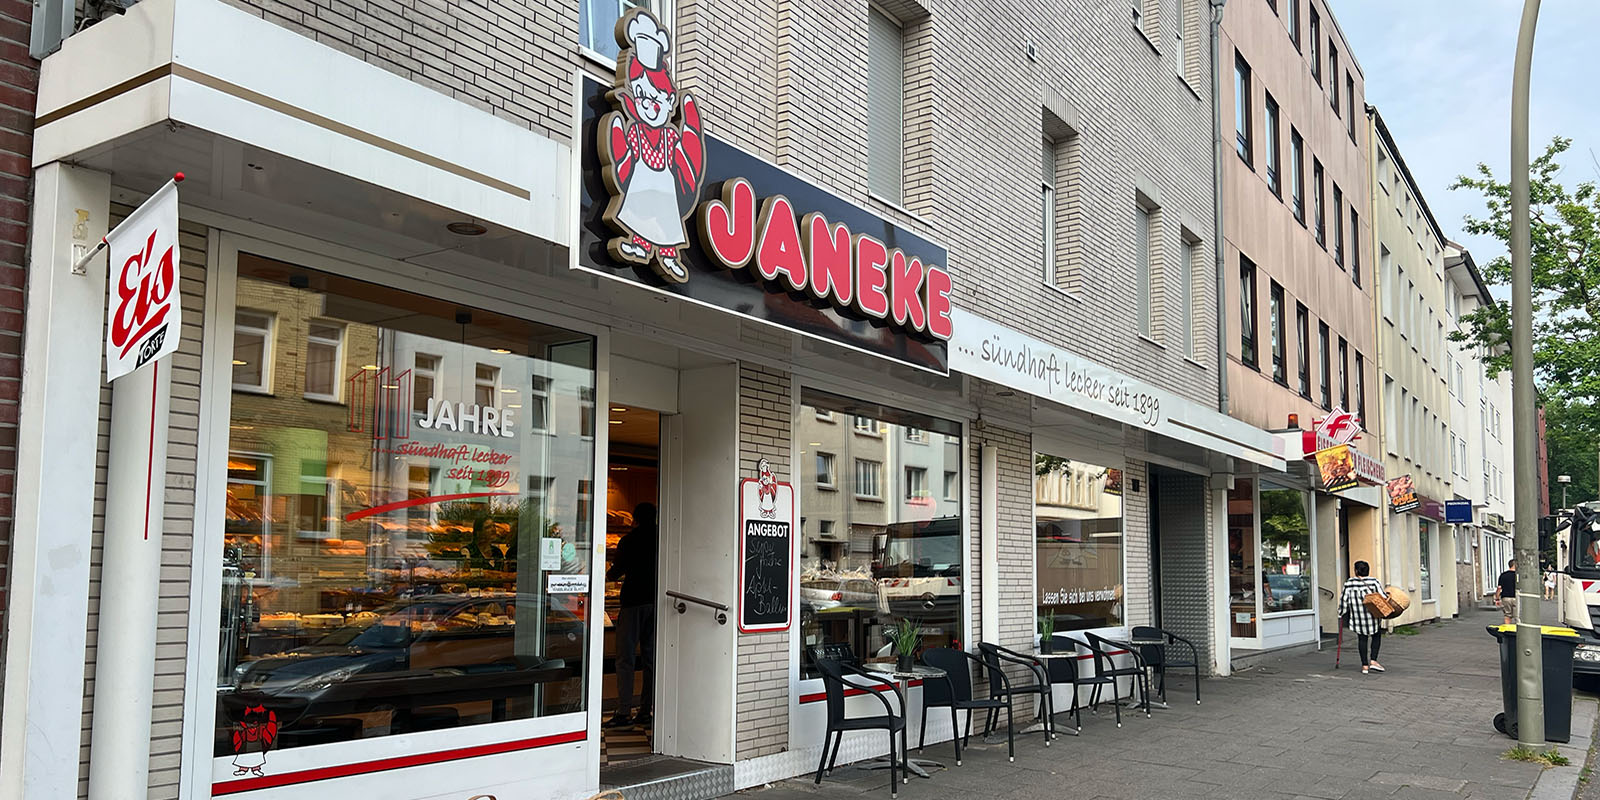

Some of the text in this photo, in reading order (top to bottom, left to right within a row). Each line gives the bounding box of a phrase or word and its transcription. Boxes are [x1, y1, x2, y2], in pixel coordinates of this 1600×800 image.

[698, 177, 953, 341] JANEKE
[111, 228, 174, 348] Eis
[138, 331, 165, 364] TORTE
[981, 334, 1060, 394] sündhaft
[1065, 362, 1104, 399] lecker
[1108, 379, 1129, 409] seit
[1133, 392, 1160, 427] 1899
[419, 398, 514, 438] JAHRE
[472, 447, 512, 465] lecker
[448, 465, 510, 488] seit 1899
[747, 522, 788, 538] ANGEBOT
[1042, 587, 1059, 604] Lassen
[1060, 587, 1068, 604] Sie
[1068, 588, 1078, 604] sich
[1086, 590, 1094, 602] uns
